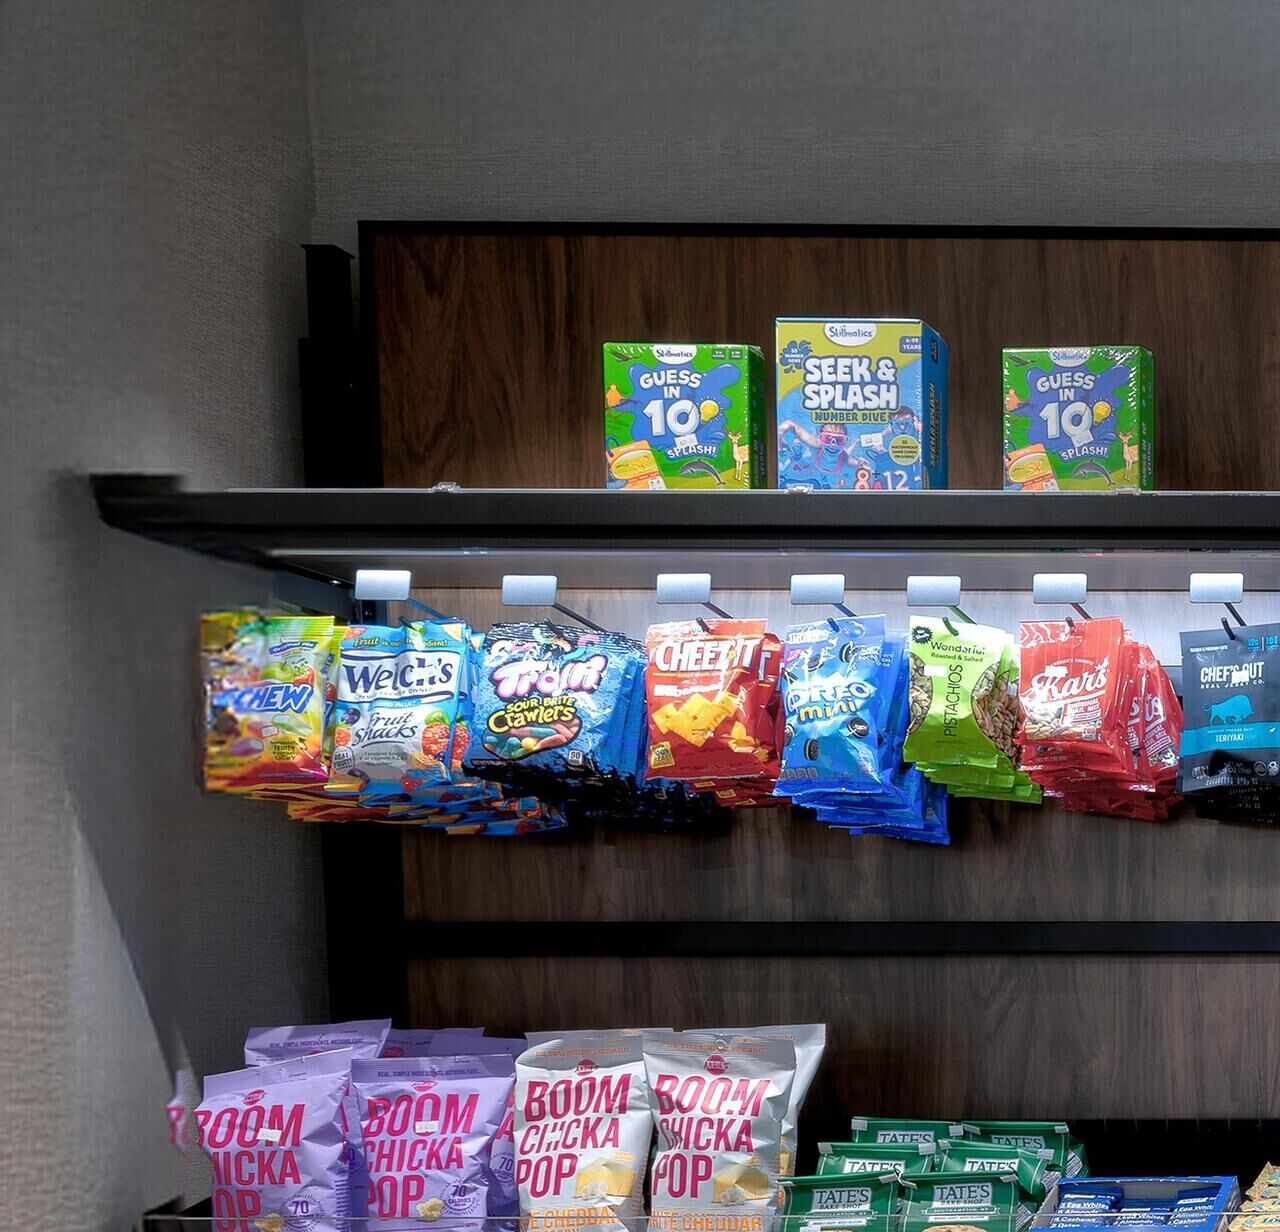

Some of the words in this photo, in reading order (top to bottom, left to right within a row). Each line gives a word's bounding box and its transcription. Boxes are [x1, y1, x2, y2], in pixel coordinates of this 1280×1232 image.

[639, 369, 702, 390] GUESS
[805, 358, 872, 384] SEEK
[877, 358, 897, 383] &
[1036, 371, 1096, 392] GUESS
[663, 386, 681, 399] IN
[804, 384, 897, 410] SPLASH
[1059, 388, 1075, 401] IN
[642, 399, 699, 437] 10
[815, 412, 858, 422] NUMBER
[862, 412, 887, 422] DIVE
[667, 445, 717, 459] SPLASH!
[1061, 446, 1108, 460] SPLASH!
[931, 653, 957, 661] Roasted
[507, 697, 539, 713] SOUR
[543, 695, 575, 708] BRITE
[943, 663, 963, 737] PISTACHIOS
[367, 709, 412, 727] Fruit
[488, 705, 576, 733] Crawlers
[799, 699, 857, 722] mini
[352, 722, 418, 746] Snacks
[1215, 733, 1245, 743] TERIYAKI
[524, 1073, 632, 1122] BOOM
[363, 1093, 480, 1138] BOOM
[993, 1135, 1044, 1149] TATE'S
[364, 1136, 464, 1173] CHICKA
[516, 1151, 577, 1197] POP
[453, 1185, 467, 1198] 70
[816, 1188, 871, 1205] TATE'S
[935, 1184, 991, 1200] TATE'S
[682, 1212, 763, 1232] CHEDDAR
